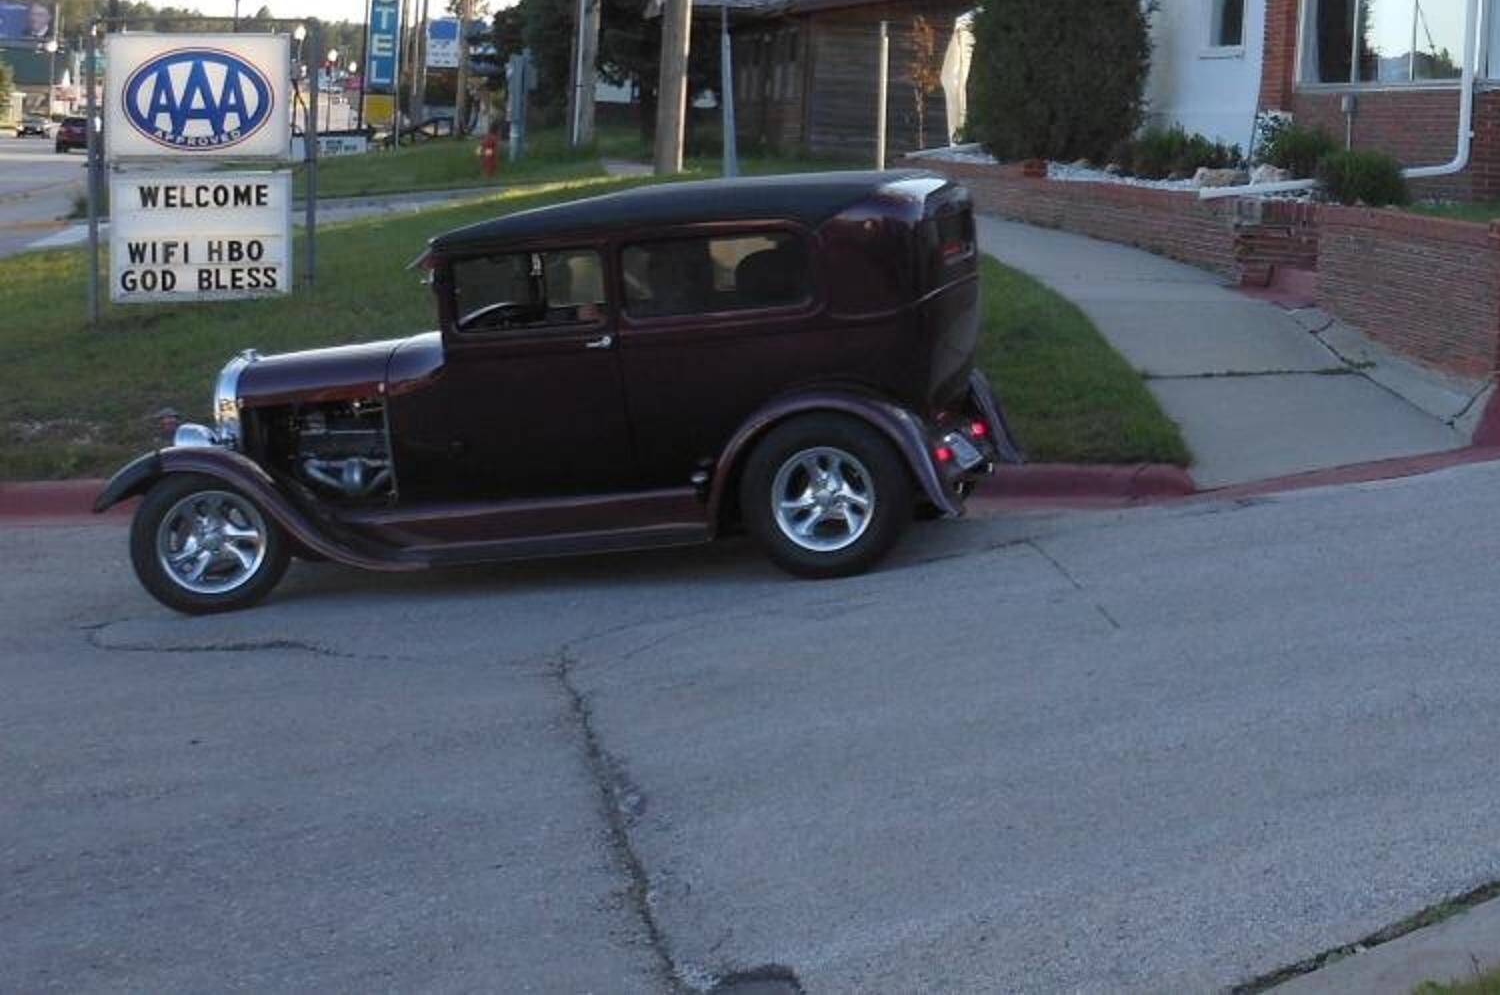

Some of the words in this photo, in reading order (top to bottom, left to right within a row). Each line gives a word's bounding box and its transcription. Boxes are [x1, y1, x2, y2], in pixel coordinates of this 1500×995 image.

[147, 58, 249, 136] AAA
[153, 128, 242, 147] APPROVED
[138, 184, 269, 208] WELCOME
[127, 241, 190, 265] WIFI
[207, 239, 265, 262] HBO
[120, 269, 177, 292] GOD
[197, 266, 278, 291] BLESS
